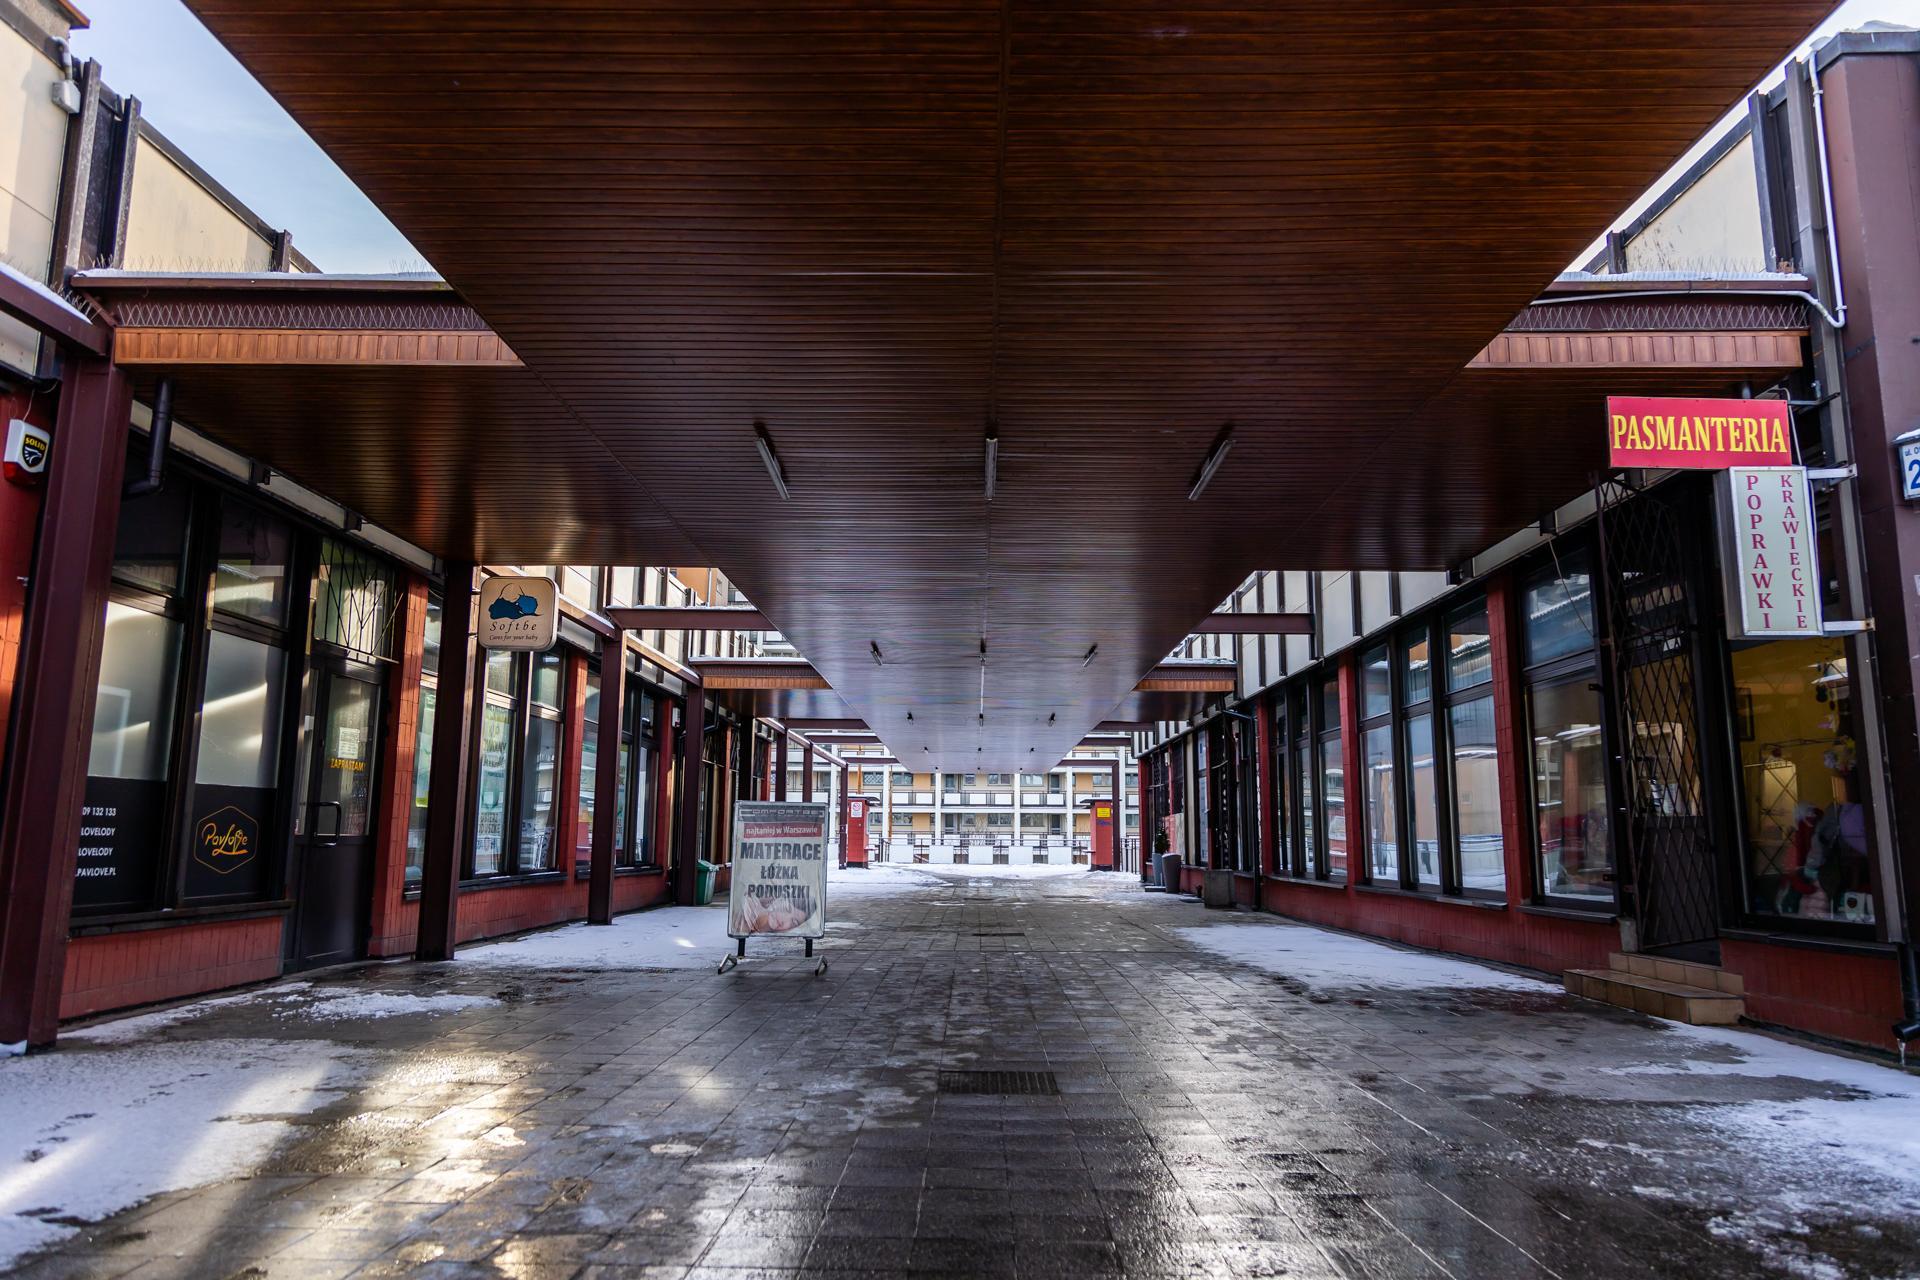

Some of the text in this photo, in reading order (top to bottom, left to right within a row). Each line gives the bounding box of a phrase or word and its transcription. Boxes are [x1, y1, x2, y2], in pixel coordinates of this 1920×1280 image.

[1612, 415, 1788, 453] PASMANTERIA
[25, 437, 46, 451] SOLID
[1746, 475, 1773, 629] POPRAWKI
[1780, 475, 1808, 629] KRAWIECKIE
[489, 620, 537, 634] Softbe
[92, 807, 104, 816] 132
[105, 807, 117, 817] 133
[746, 826, 775, 836] najtaniej
[782, 825, 818, 834] Warszawie
[740, 842, 822, 861] MATERACE
[761, 863, 799, 880] ŁÓŻKA
[747, 884, 811, 900] PODUSZKI
